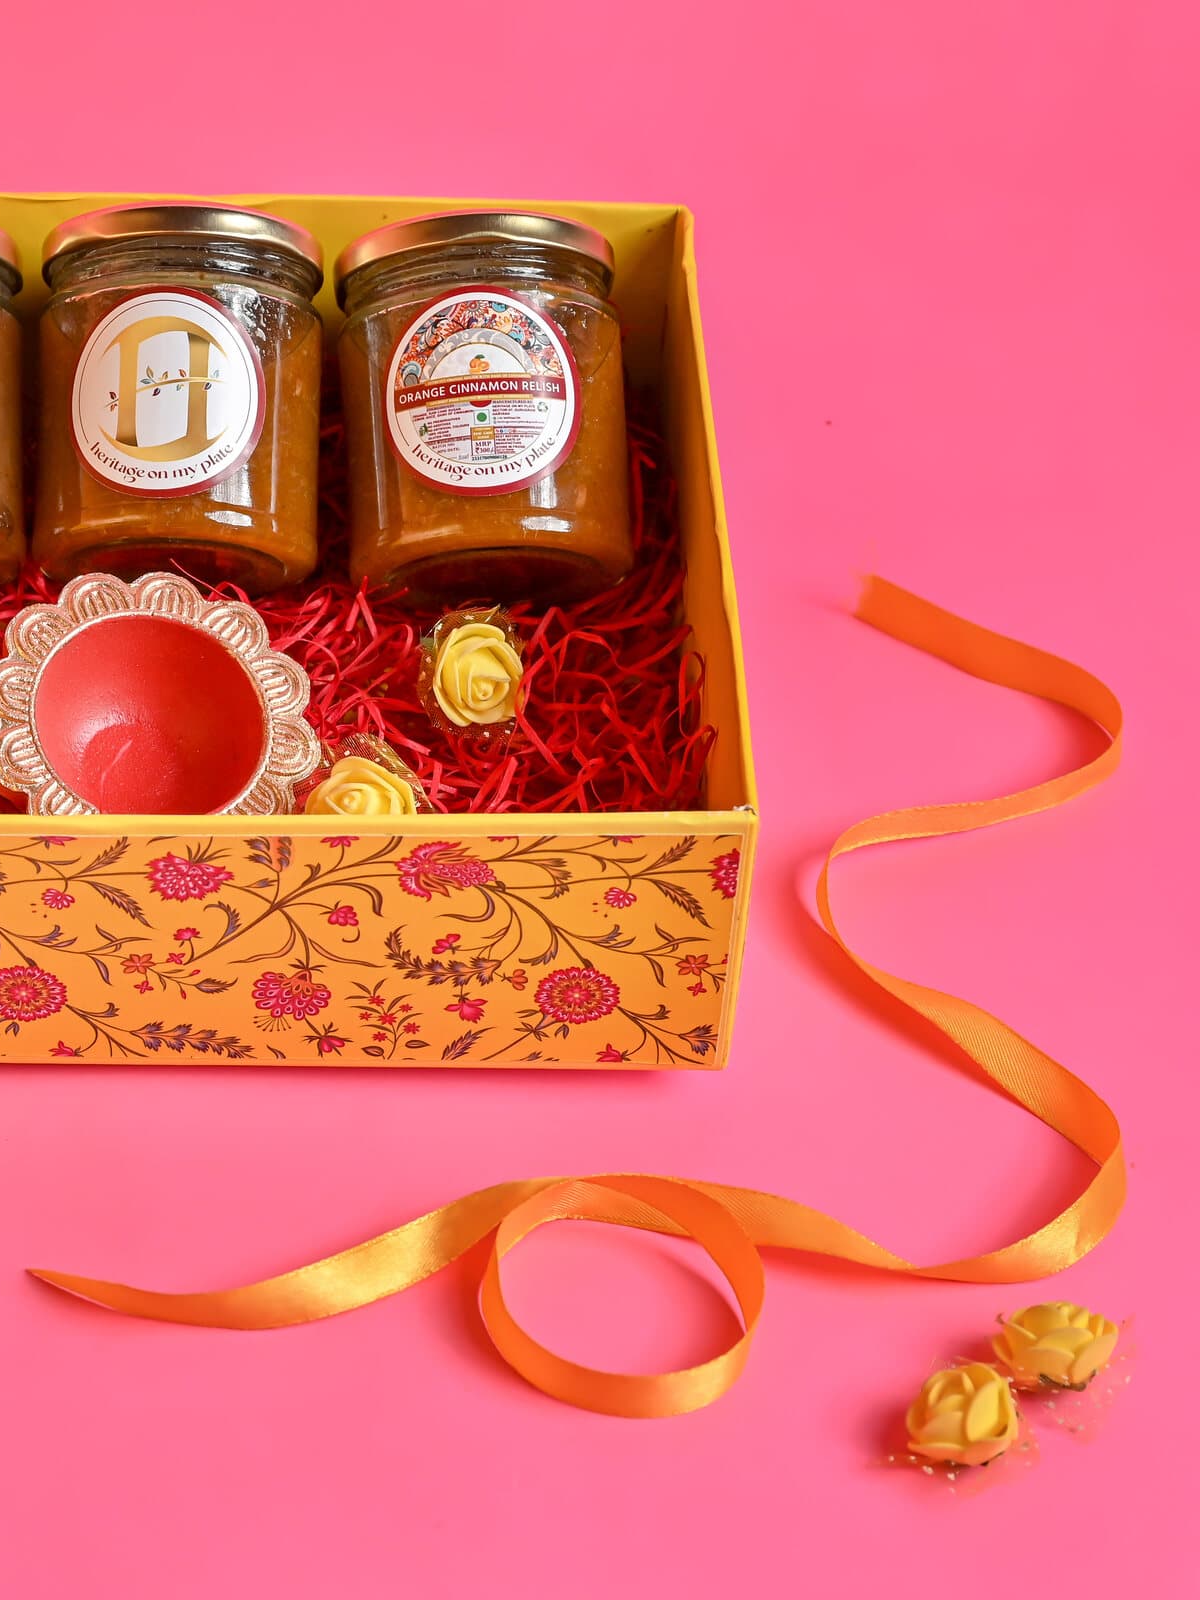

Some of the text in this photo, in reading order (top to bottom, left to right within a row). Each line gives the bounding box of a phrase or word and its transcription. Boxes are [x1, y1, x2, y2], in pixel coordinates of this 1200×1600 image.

[400, 387, 445, 404] ORANGE
[450, 381, 518, 395] CINNAMON
[522, 381, 559, 393] RELISH
[90, 442, 233, 484] heritage on my plate
[412, 444, 471, 481] heritage
[474, 466, 494, 476] on
[499, 460, 523, 473] my
[526, 437, 556, 467] plate
